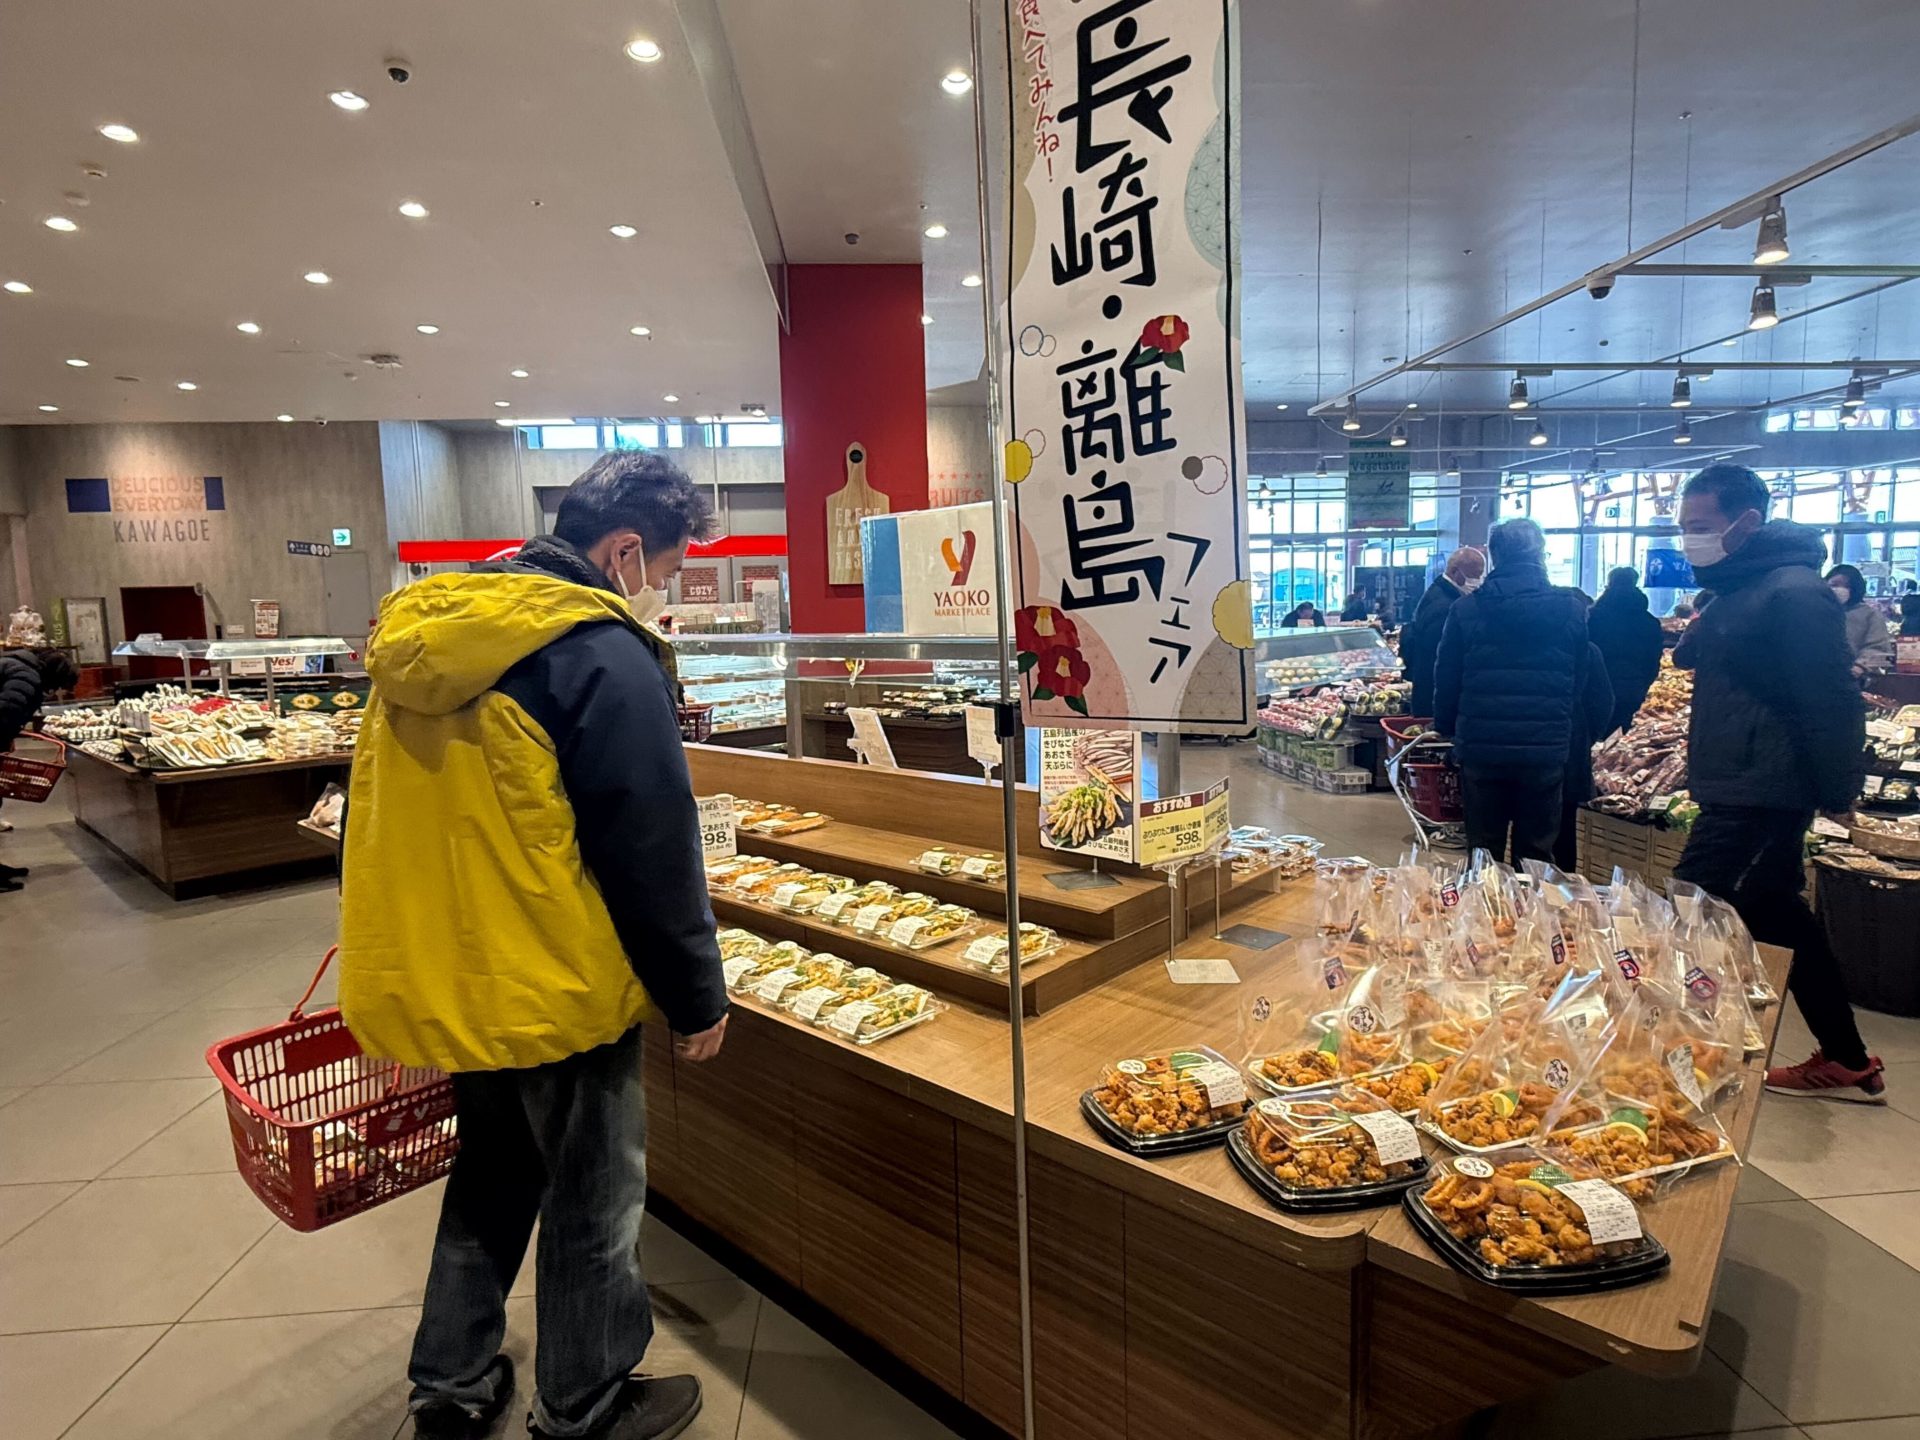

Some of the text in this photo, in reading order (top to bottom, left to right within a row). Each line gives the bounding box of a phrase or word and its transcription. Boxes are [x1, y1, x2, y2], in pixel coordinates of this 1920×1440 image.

[111, 476, 204, 494] DELICIOUS
[113, 496, 206, 512] EVERYDAY
[113, 519, 211, 543] KAWAGOE
[689, 585, 713, 596] COZY
[933, 589, 990, 607] YAOKO
[934, 607, 991, 617] MARKETPLACE
[1043, 739, 1078, 748] きびなごと
[1044, 750, 1073, 759] あおさを
[1152, 796, 1192, 813] おすすめ品
